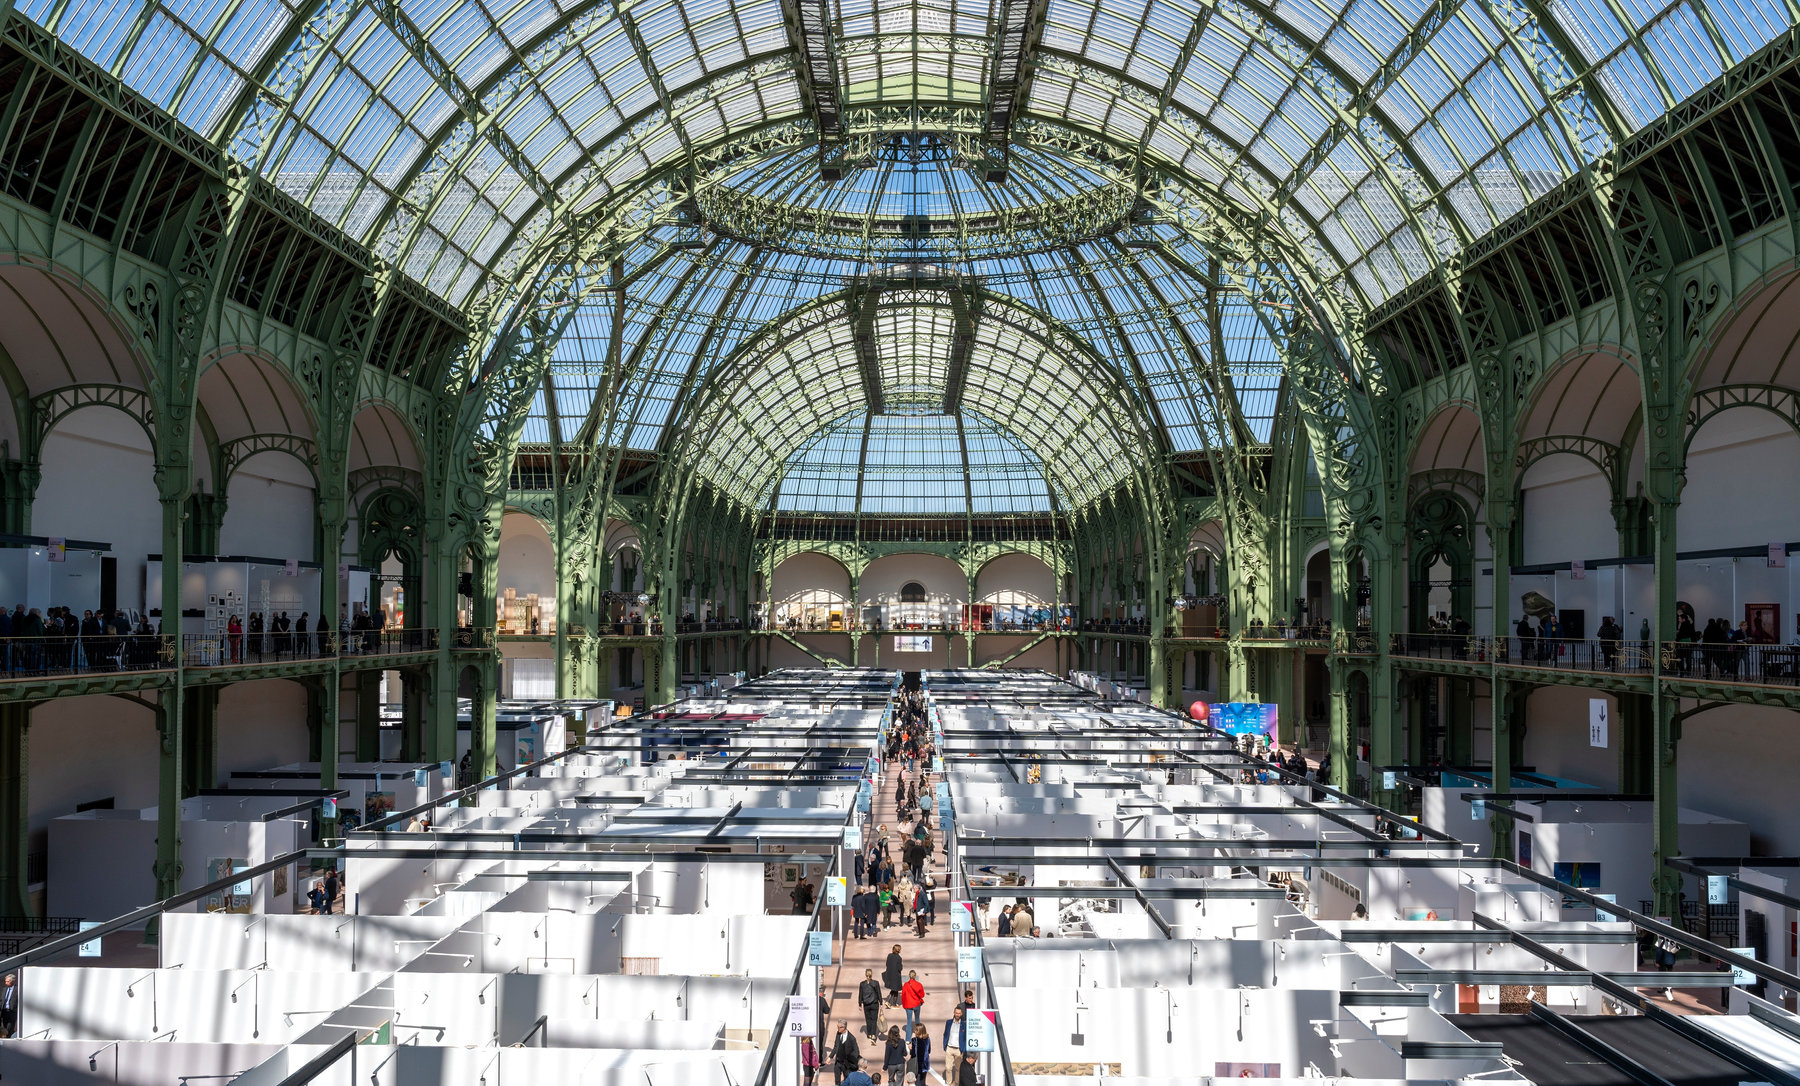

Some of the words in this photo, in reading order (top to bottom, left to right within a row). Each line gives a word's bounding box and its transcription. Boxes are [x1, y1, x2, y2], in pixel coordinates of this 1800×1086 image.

[811, 953, 820, 961] D4
[959, 970, 969, 978] C4
[1733, 970, 1743, 978] B2
[791, 1022, 803, 1032] D3
[968, 1038, 979, 1048] C3
